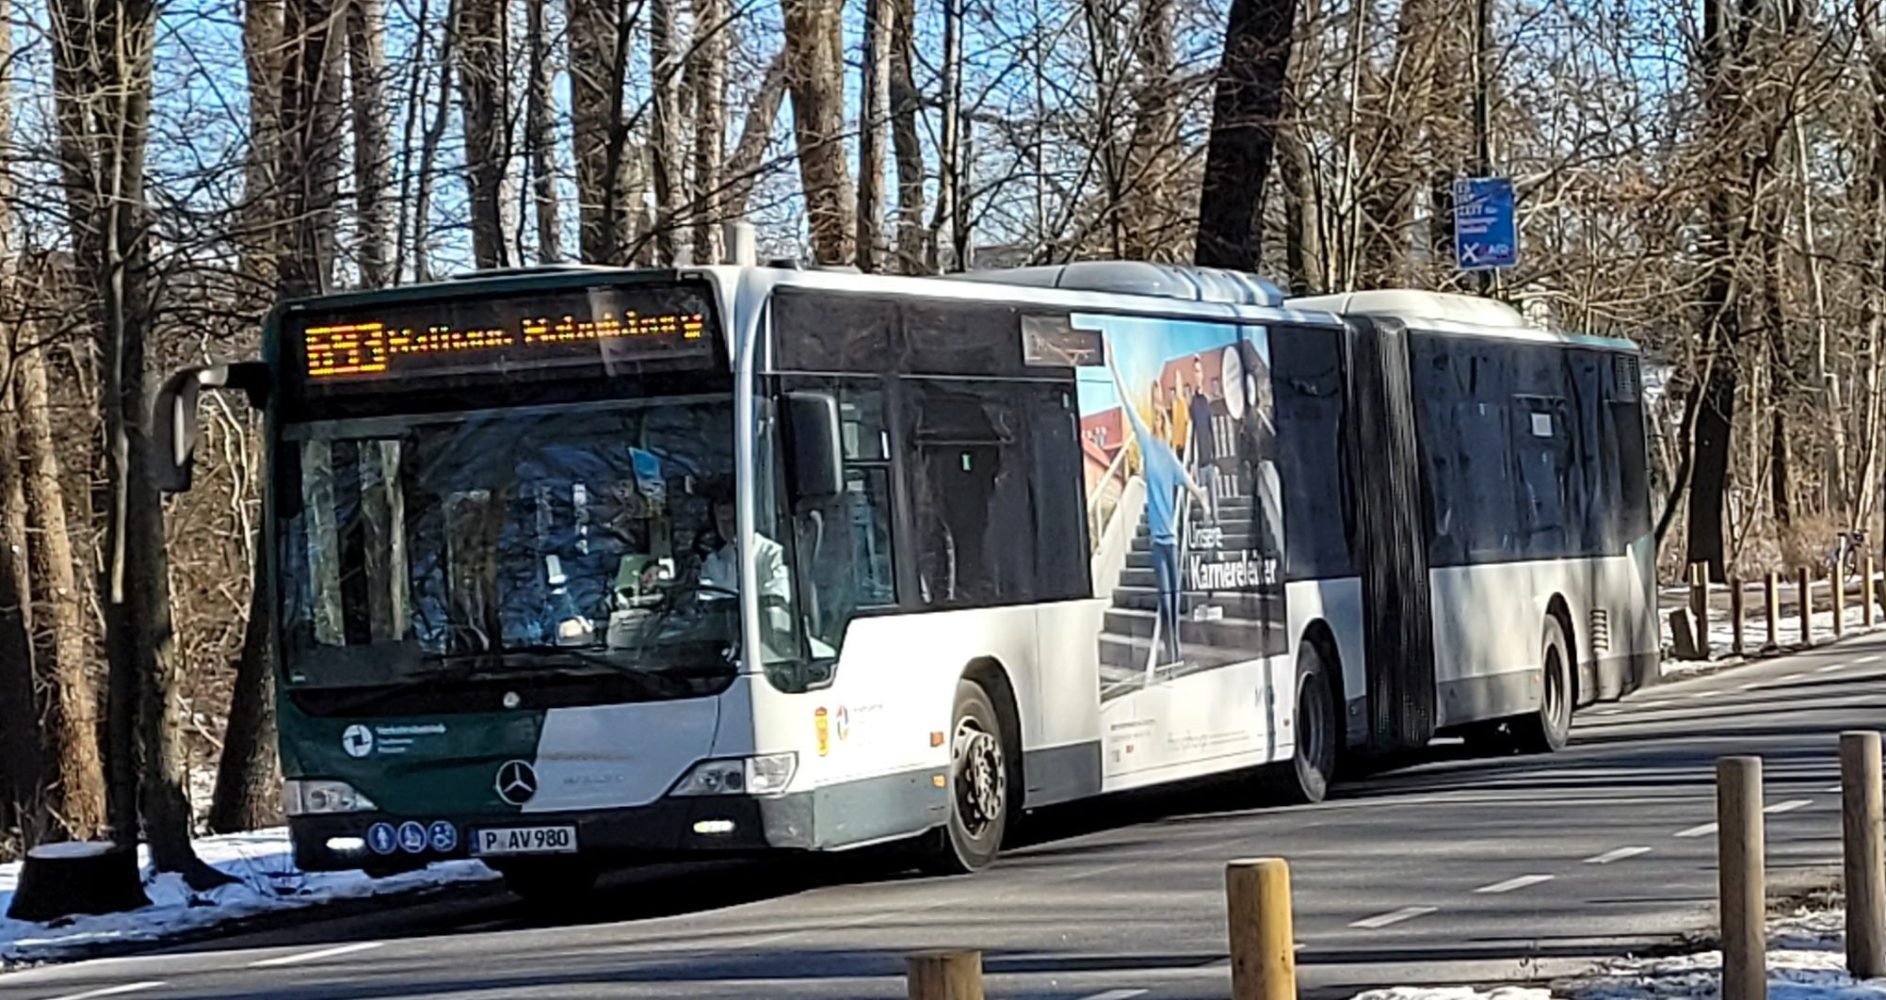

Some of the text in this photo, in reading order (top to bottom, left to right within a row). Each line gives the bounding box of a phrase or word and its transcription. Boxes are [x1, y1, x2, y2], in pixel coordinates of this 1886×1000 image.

[305, 323, 387, 375] 693
[485, 828, 569, 850] P AV 980
